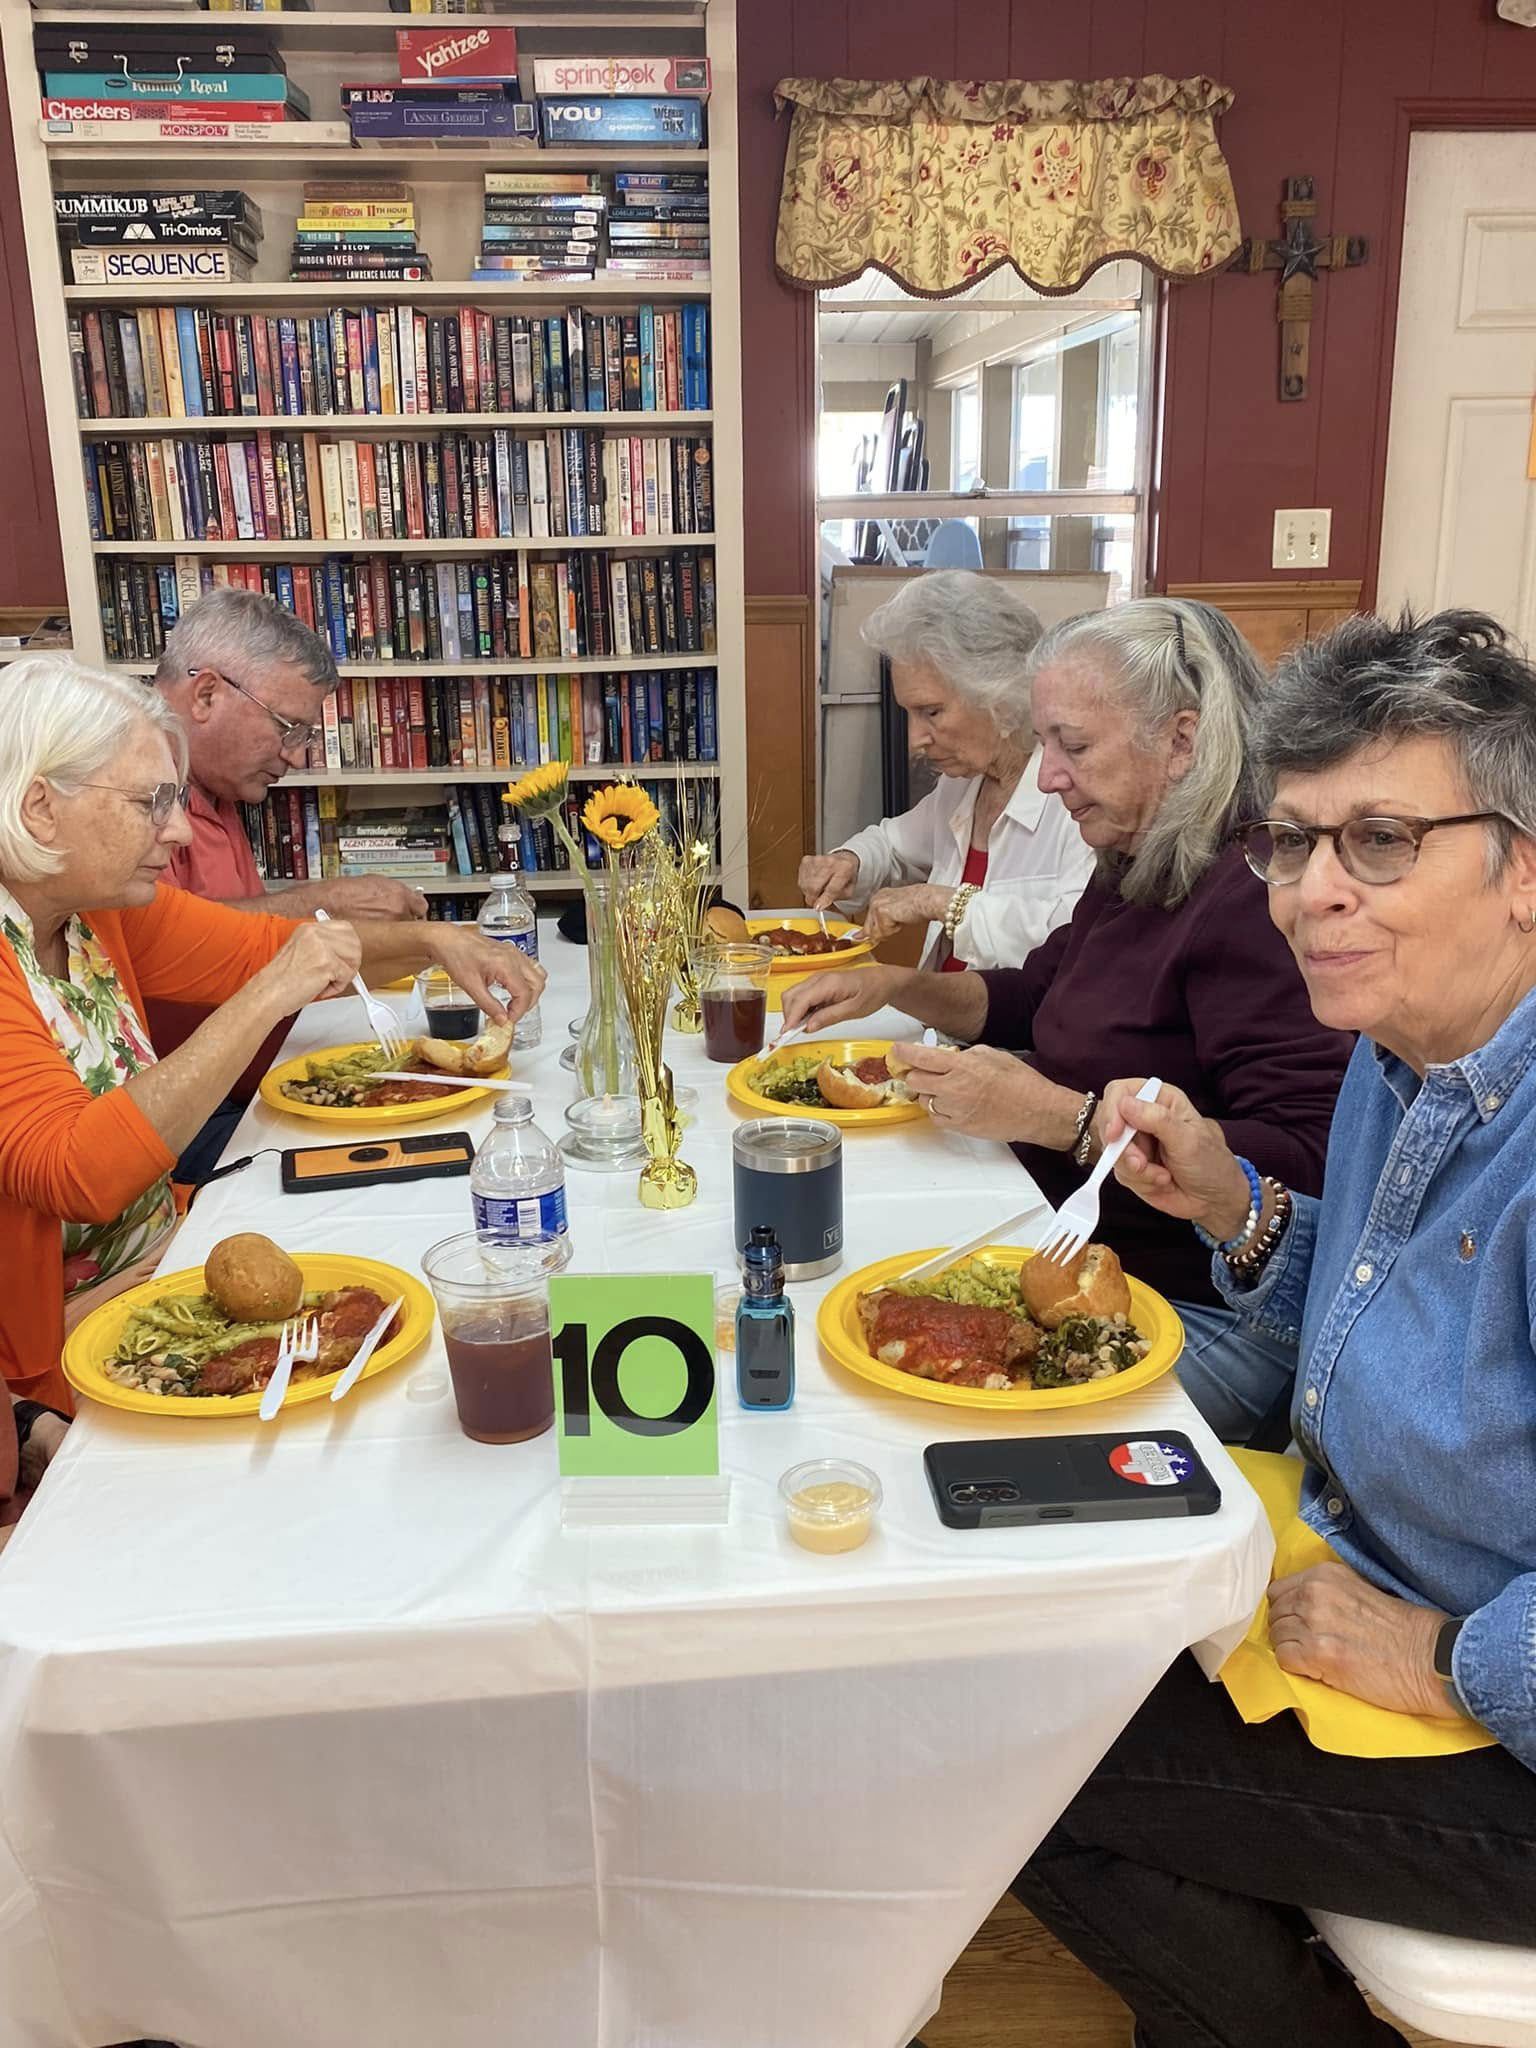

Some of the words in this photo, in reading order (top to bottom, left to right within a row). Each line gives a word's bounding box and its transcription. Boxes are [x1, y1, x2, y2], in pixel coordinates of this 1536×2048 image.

[416, 29, 490, 77] Yahtzee
[190, 79, 228, 94] Royal
[48, 101, 131, 120] Checkers
[410, 112, 439, 122] ANNE
[548, 107, 602, 121] YOU
[161, 125, 228, 137] MONOPOLY
[55, 198, 148, 214] RUMMIKUB
[108, 253, 225, 276] SEQUENCE
[327, 255, 353, 265] RIVER
[346, 270, 379, 280] LAWRENCE
[379, 270, 400, 280] BLOCK
[261, 456, 274, 479] JAMES
[264, 480, 277, 515] PATTERSON
[379, 487, 392, 504] RED
[478, 487, 488, 506] TERM
[380, 505, 393, 528] MESA
[479, 507, 489, 529] LIMITS
[180, 567, 197, 598] GREG
[493, 582, 501, 603] JANCE
[496, 731, 504, 760] ATLANTIS
[552, 1316, 715, 1437] 10
